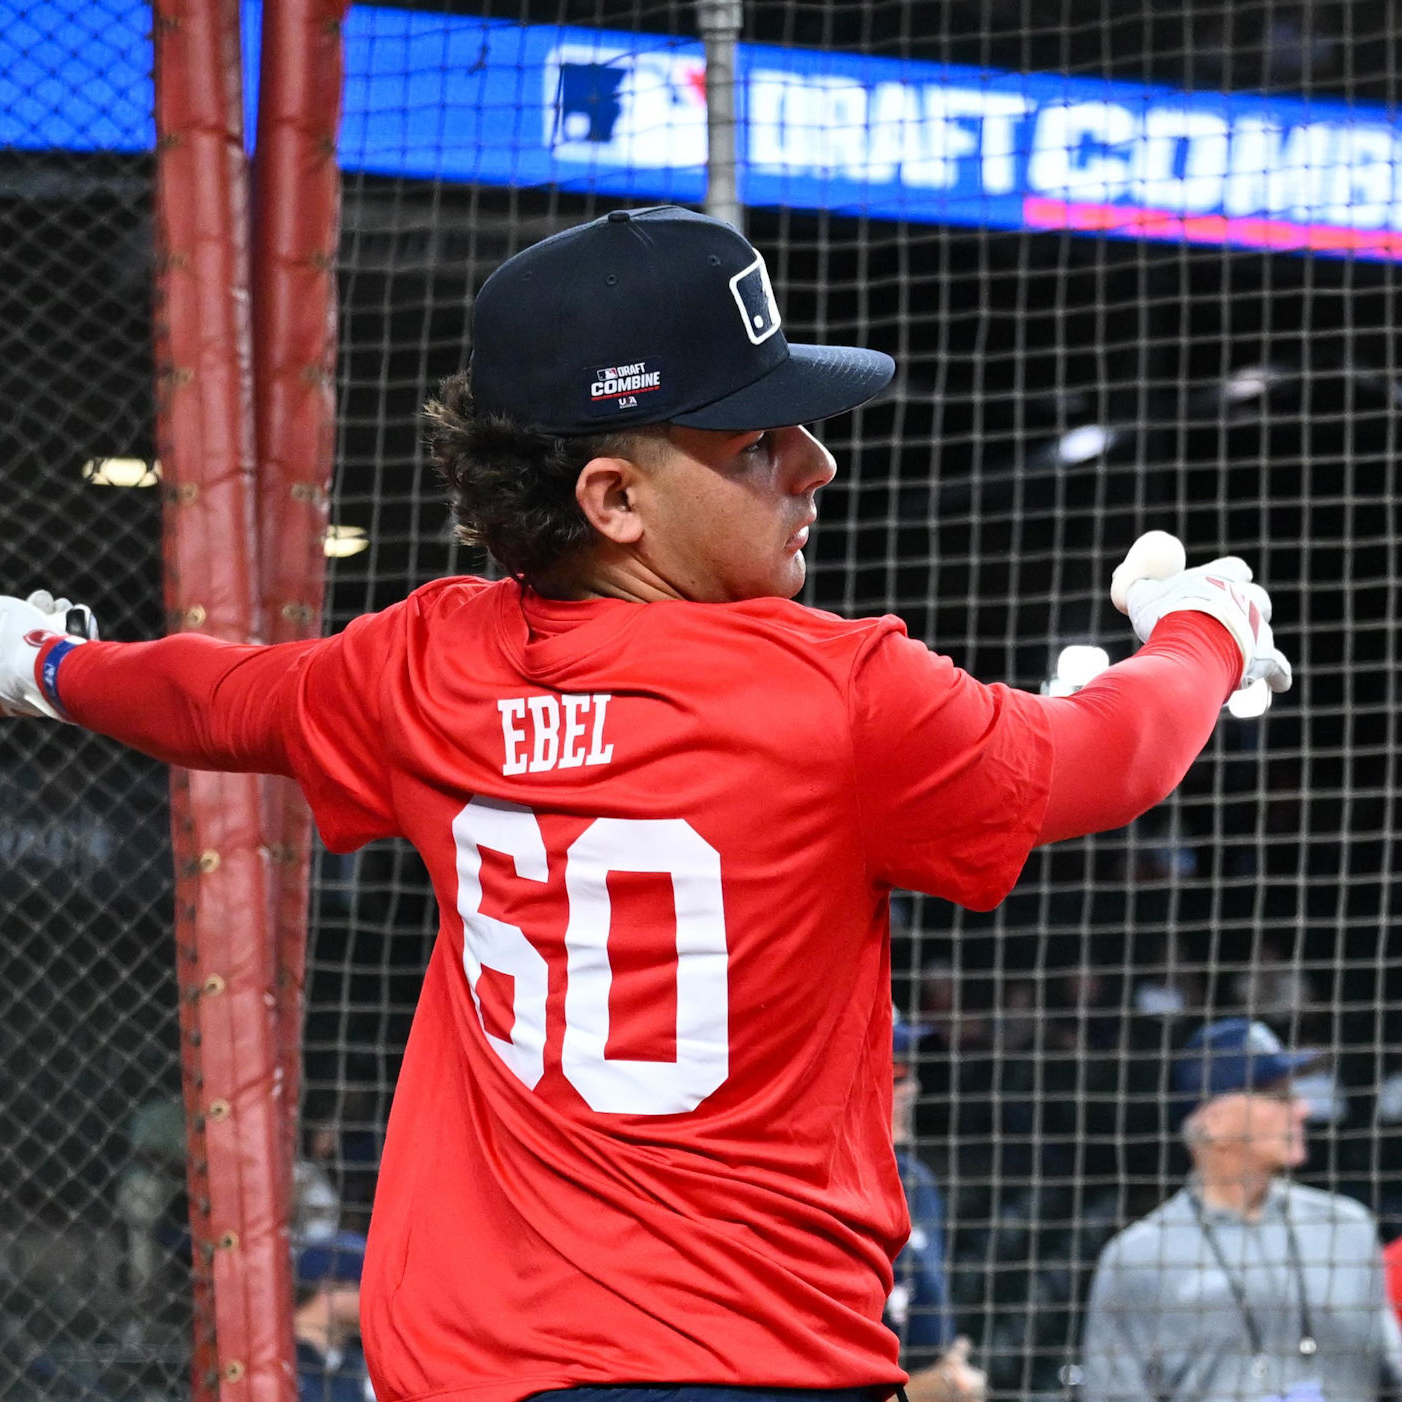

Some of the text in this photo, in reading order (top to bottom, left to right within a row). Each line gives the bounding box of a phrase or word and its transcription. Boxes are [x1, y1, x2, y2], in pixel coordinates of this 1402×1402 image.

[747, 67, 1031, 196] DRAFT
[590, 371, 661, 397] COMBINE
[617, 362, 646, 378] DRAFT
[497, 691, 615, 777] EBEL
[451, 794, 730, 1117] 60
